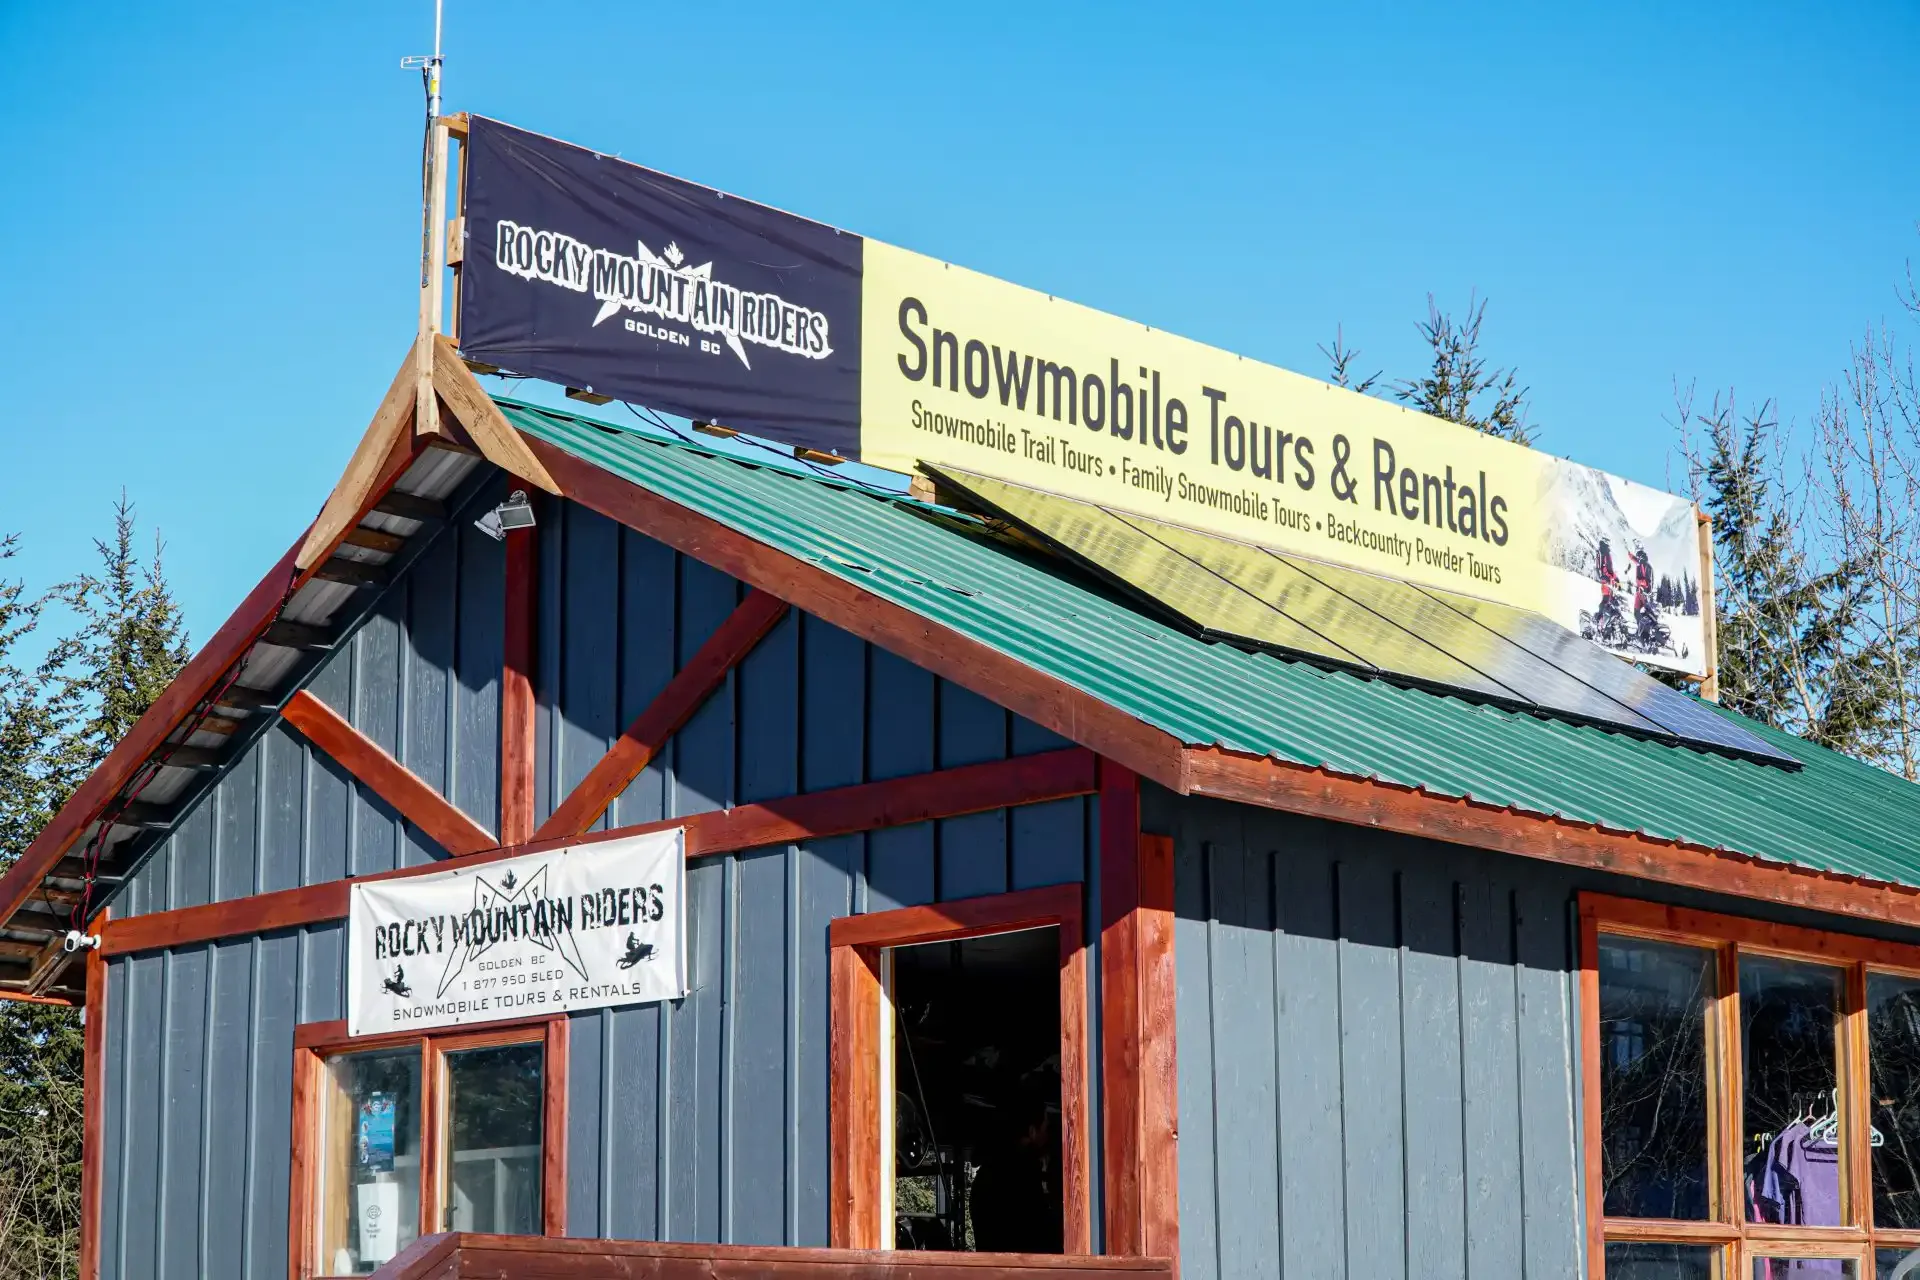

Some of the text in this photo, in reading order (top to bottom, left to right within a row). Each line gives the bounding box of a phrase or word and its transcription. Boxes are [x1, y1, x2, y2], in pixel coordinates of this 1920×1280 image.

[497, 222, 829, 354] ROCKY MOUNTAIN RIDERS
[624, 318, 721, 355] GOLDEN BC
[897, 296, 1509, 547] Snowmobile Tours & Rentals
[911, 399, 1501, 584] Snowmobile Trail Tours Family Snowmobile Tours Backcountry Powder Tours
[375, 884, 664, 960] ROCKY MOUNTAIN RIDERS
[462, 969, 564, 990] 1 877 950 SLED
[478, 954, 546, 971] GOLDEN BC
[393, 982, 641, 1021] SNOWMOBILE TOURS & RENTALS
